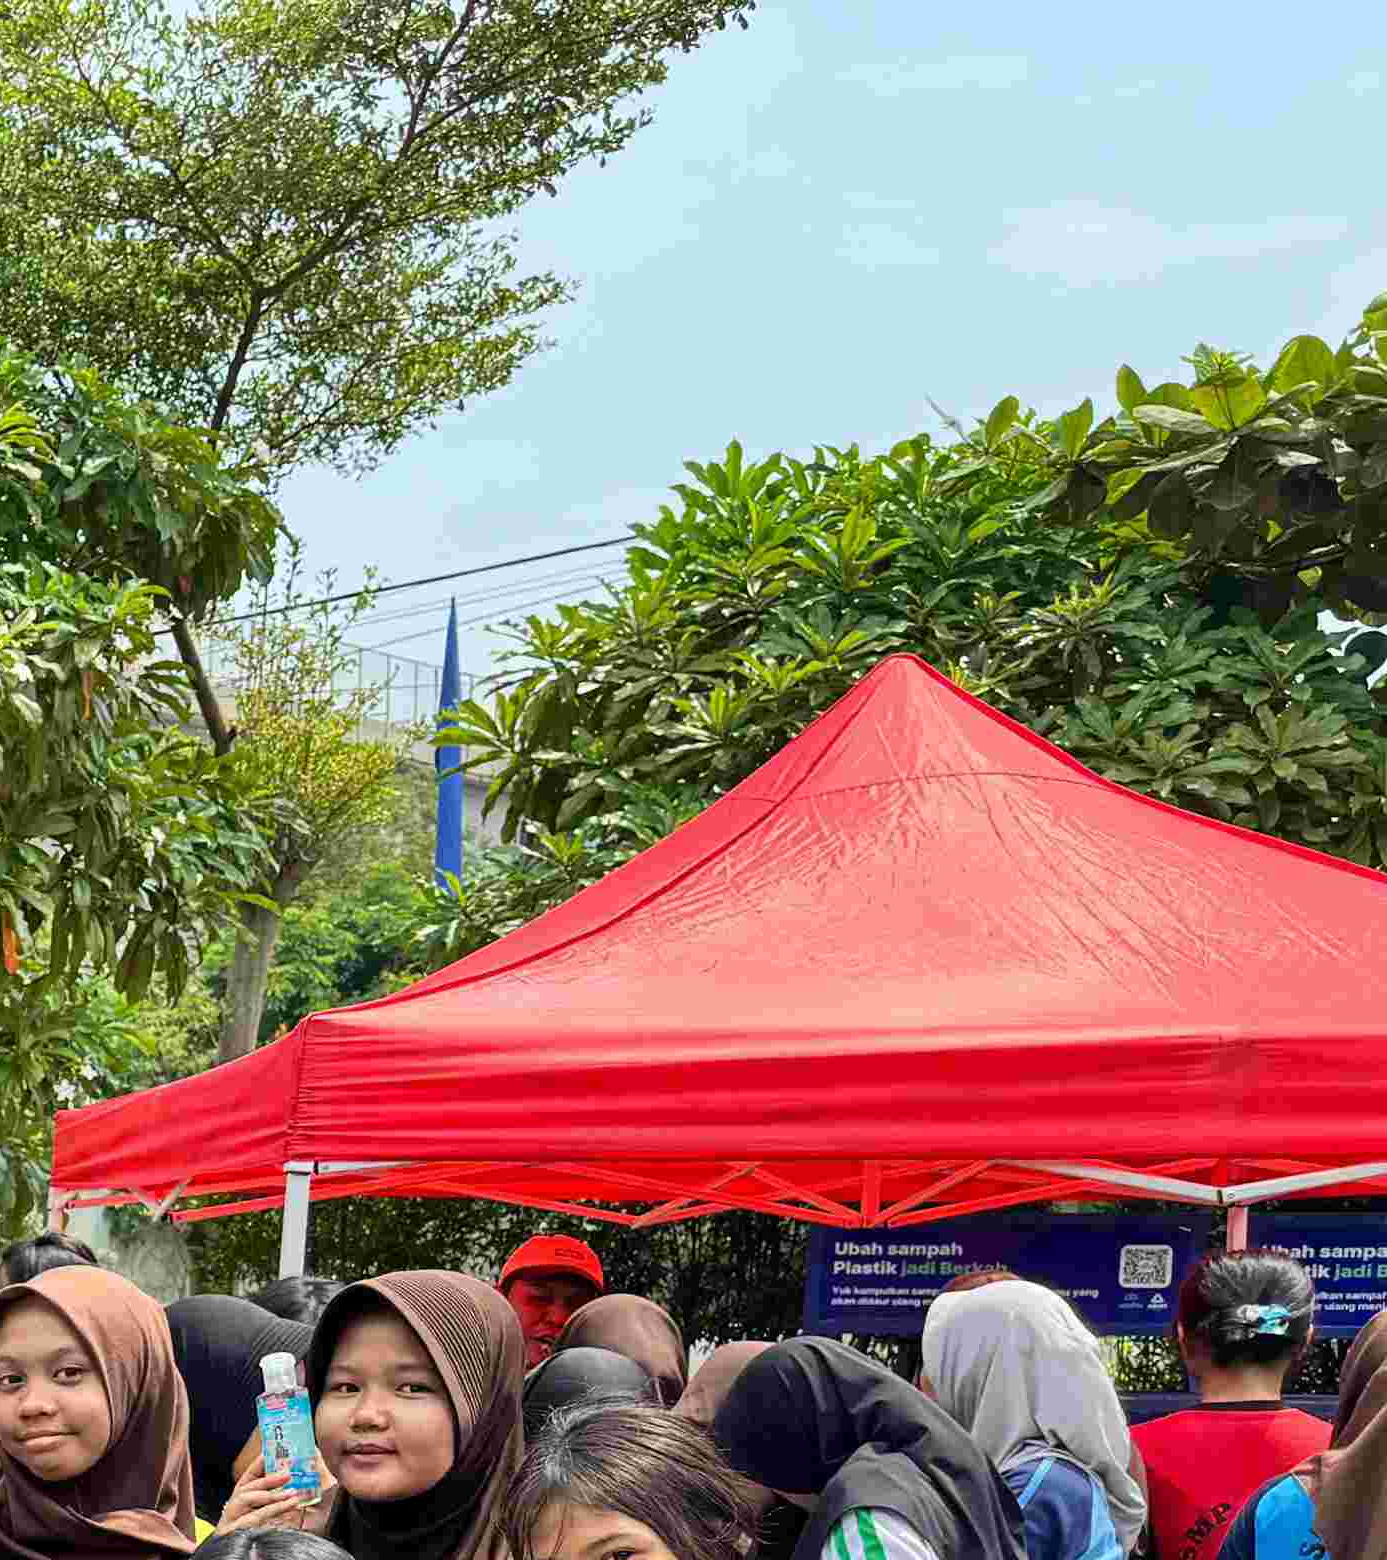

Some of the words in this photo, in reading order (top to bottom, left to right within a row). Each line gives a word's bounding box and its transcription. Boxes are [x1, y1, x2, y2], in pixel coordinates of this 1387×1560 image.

[834, 1242, 883, 1257] Ubah
[887, 1241, 963, 1259] sampah
[1319, 1246, 1387, 1261] sampa
[833, 1261, 898, 1275] Plastik
[900, 1261, 936, 1278] jadi
[1333, 1264, 1372, 1281] jadi
